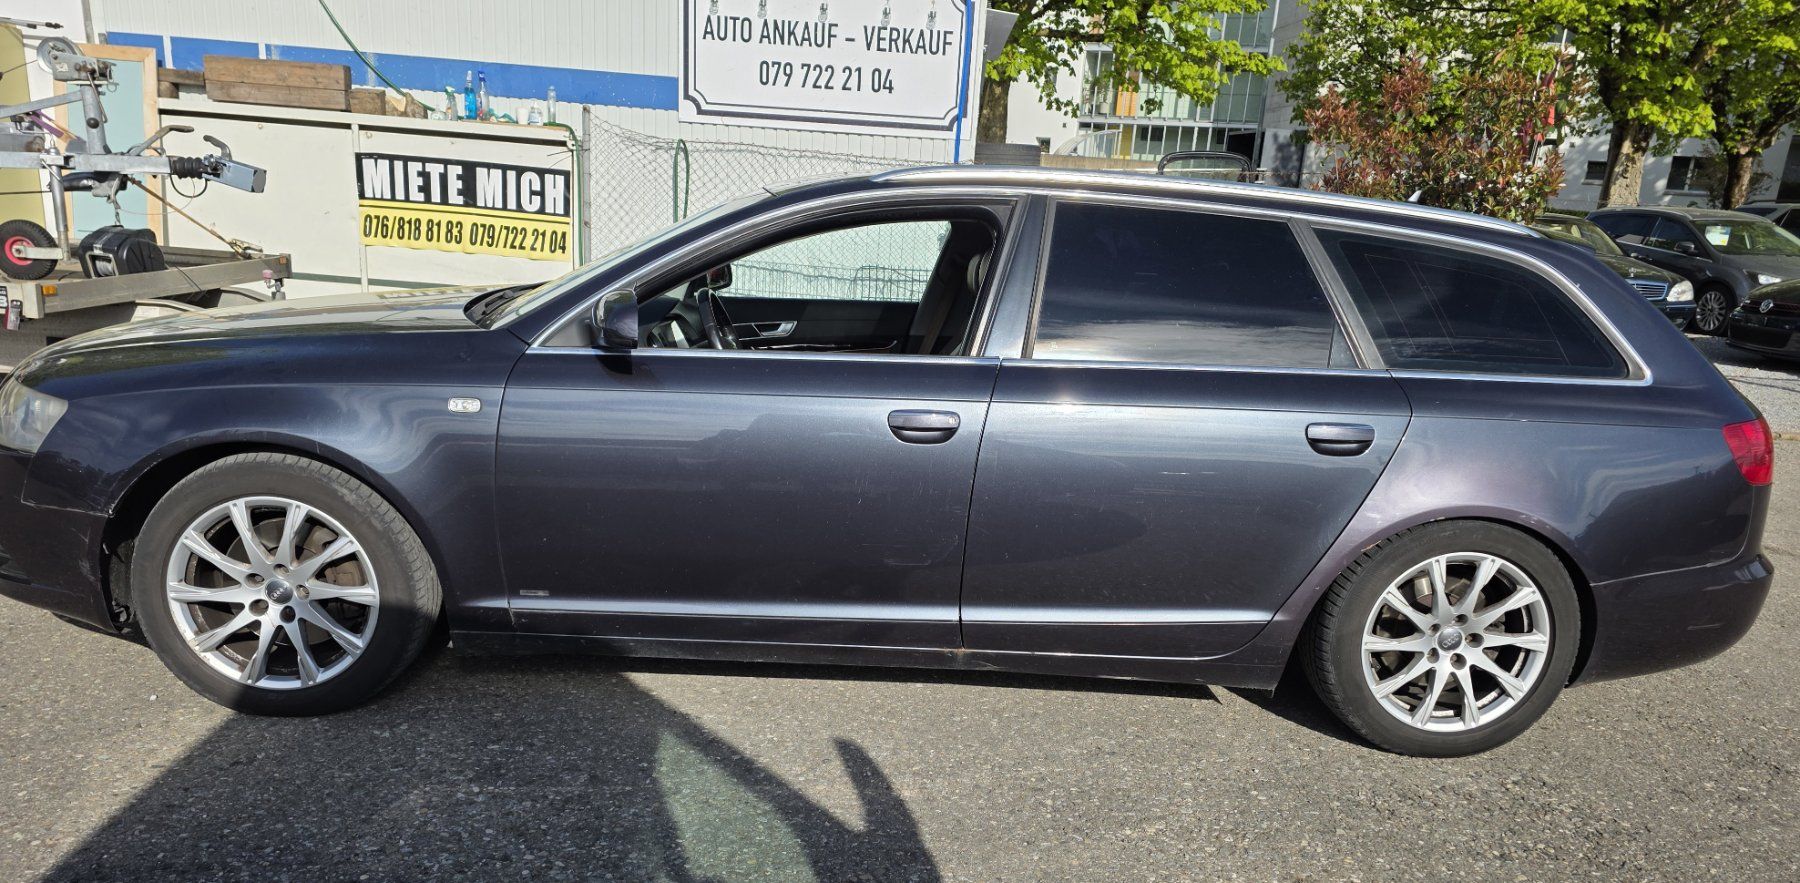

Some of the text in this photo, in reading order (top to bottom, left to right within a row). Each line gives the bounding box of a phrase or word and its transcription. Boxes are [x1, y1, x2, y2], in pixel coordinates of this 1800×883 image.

[702, 15, 752, 43] AUTO
[759, 18, 839, 48] ANKAUF
[863, 25, 954, 56] VERKAUF
[759, 60, 894, 94] 079 722 21 04
[361, 158, 565, 215] MIETE MICH
[363, 214, 567, 254] 076/818 81 83 079/722 21 04
